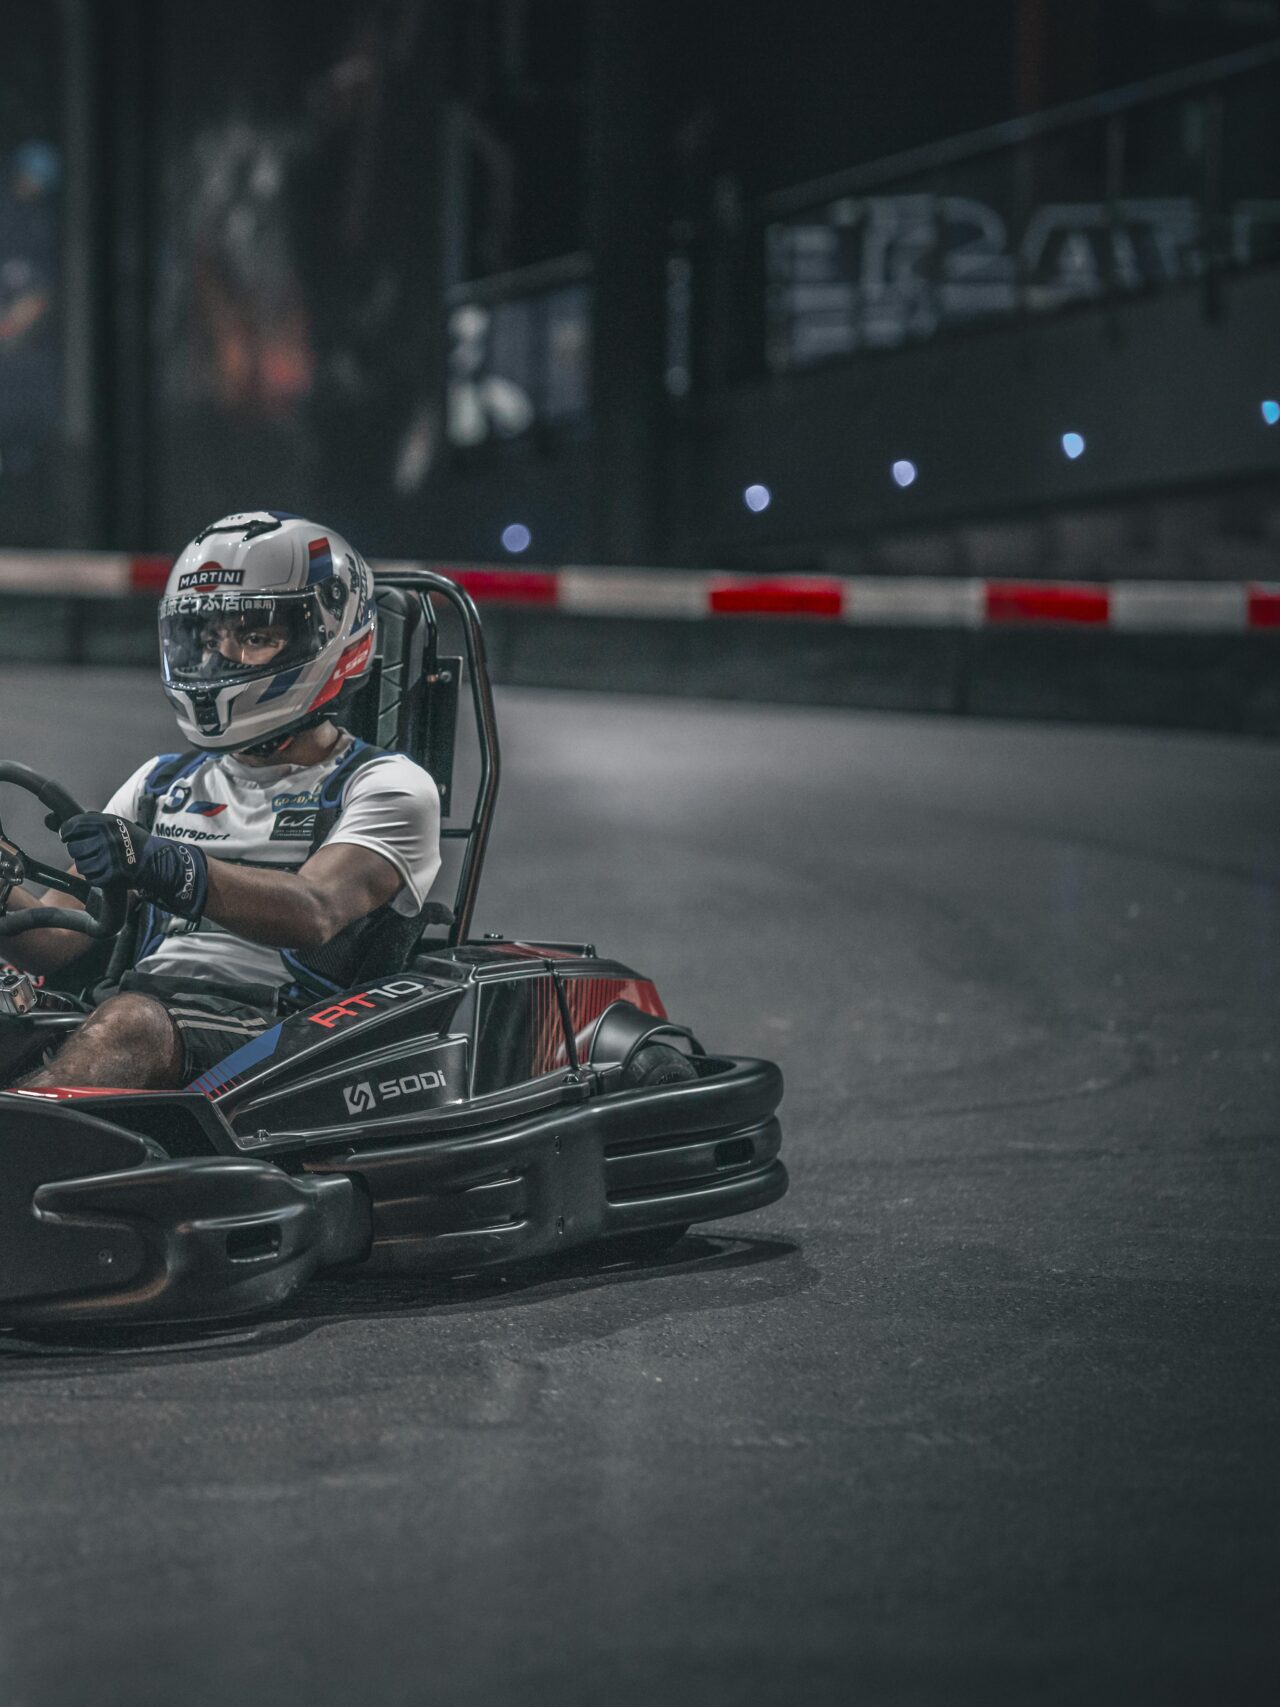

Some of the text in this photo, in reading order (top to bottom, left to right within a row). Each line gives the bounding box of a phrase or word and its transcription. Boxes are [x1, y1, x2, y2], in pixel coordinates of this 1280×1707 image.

[179, 571, 242, 588] MARTINI
[116, 818, 137, 865] sparco
[155, 822, 231, 842] Motorsport
[308, 980, 425, 1029] RT10
